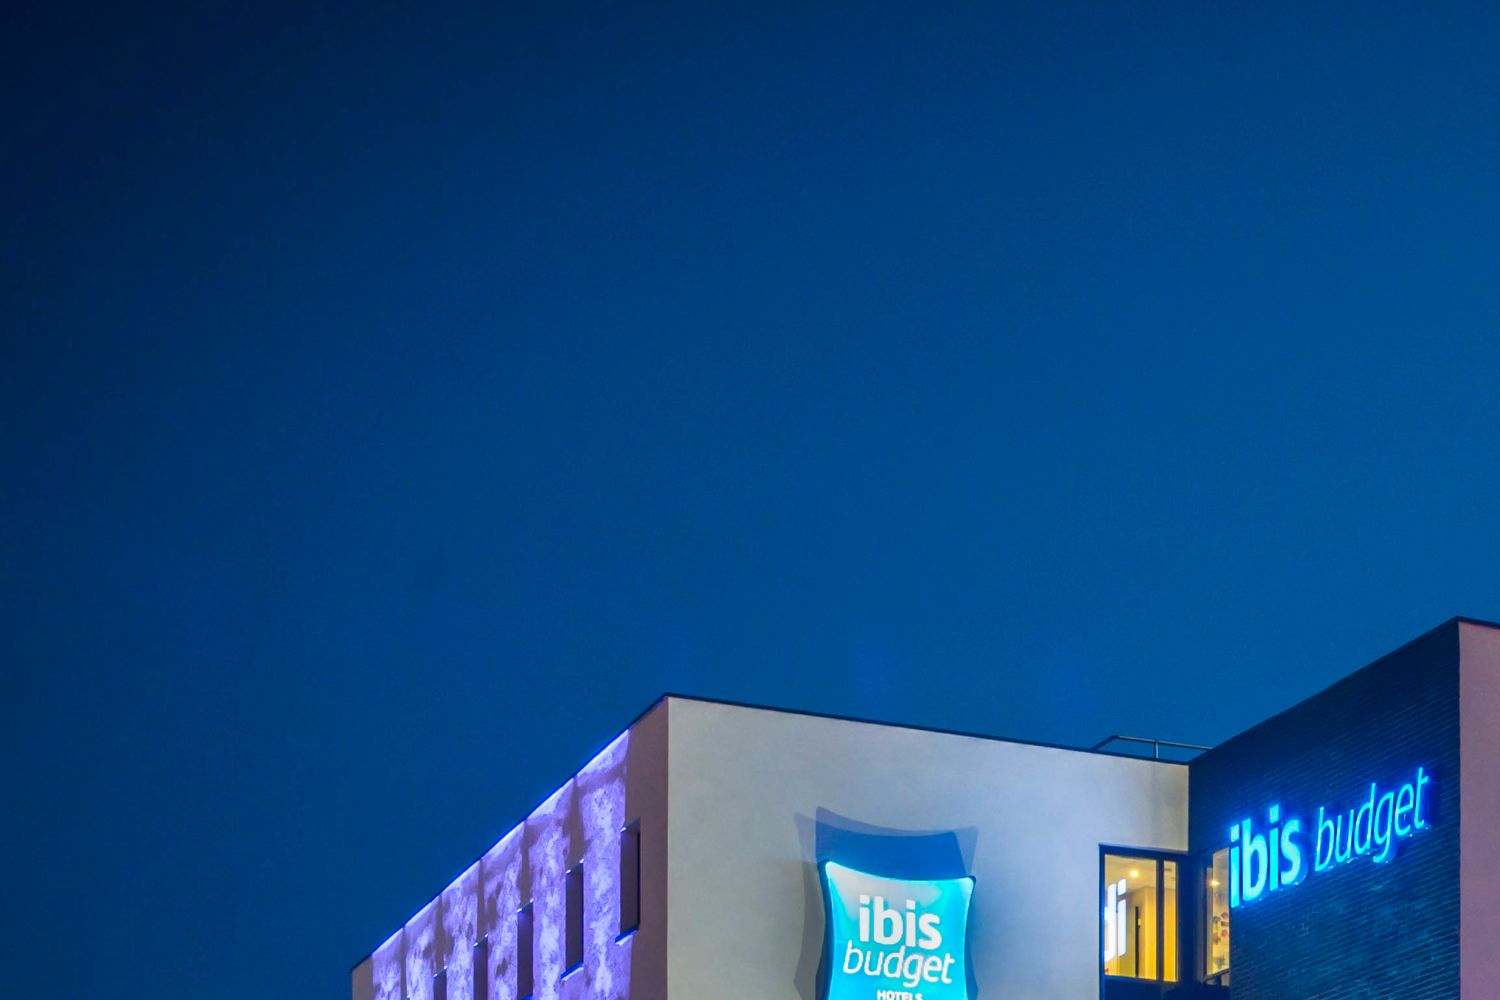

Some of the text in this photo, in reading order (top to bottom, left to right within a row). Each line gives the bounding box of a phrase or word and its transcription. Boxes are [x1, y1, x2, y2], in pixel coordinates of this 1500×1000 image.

[1231, 767, 1430, 908] ibis budget
[859, 894, 942, 950] ibis
[842, 939, 955, 988] budget
